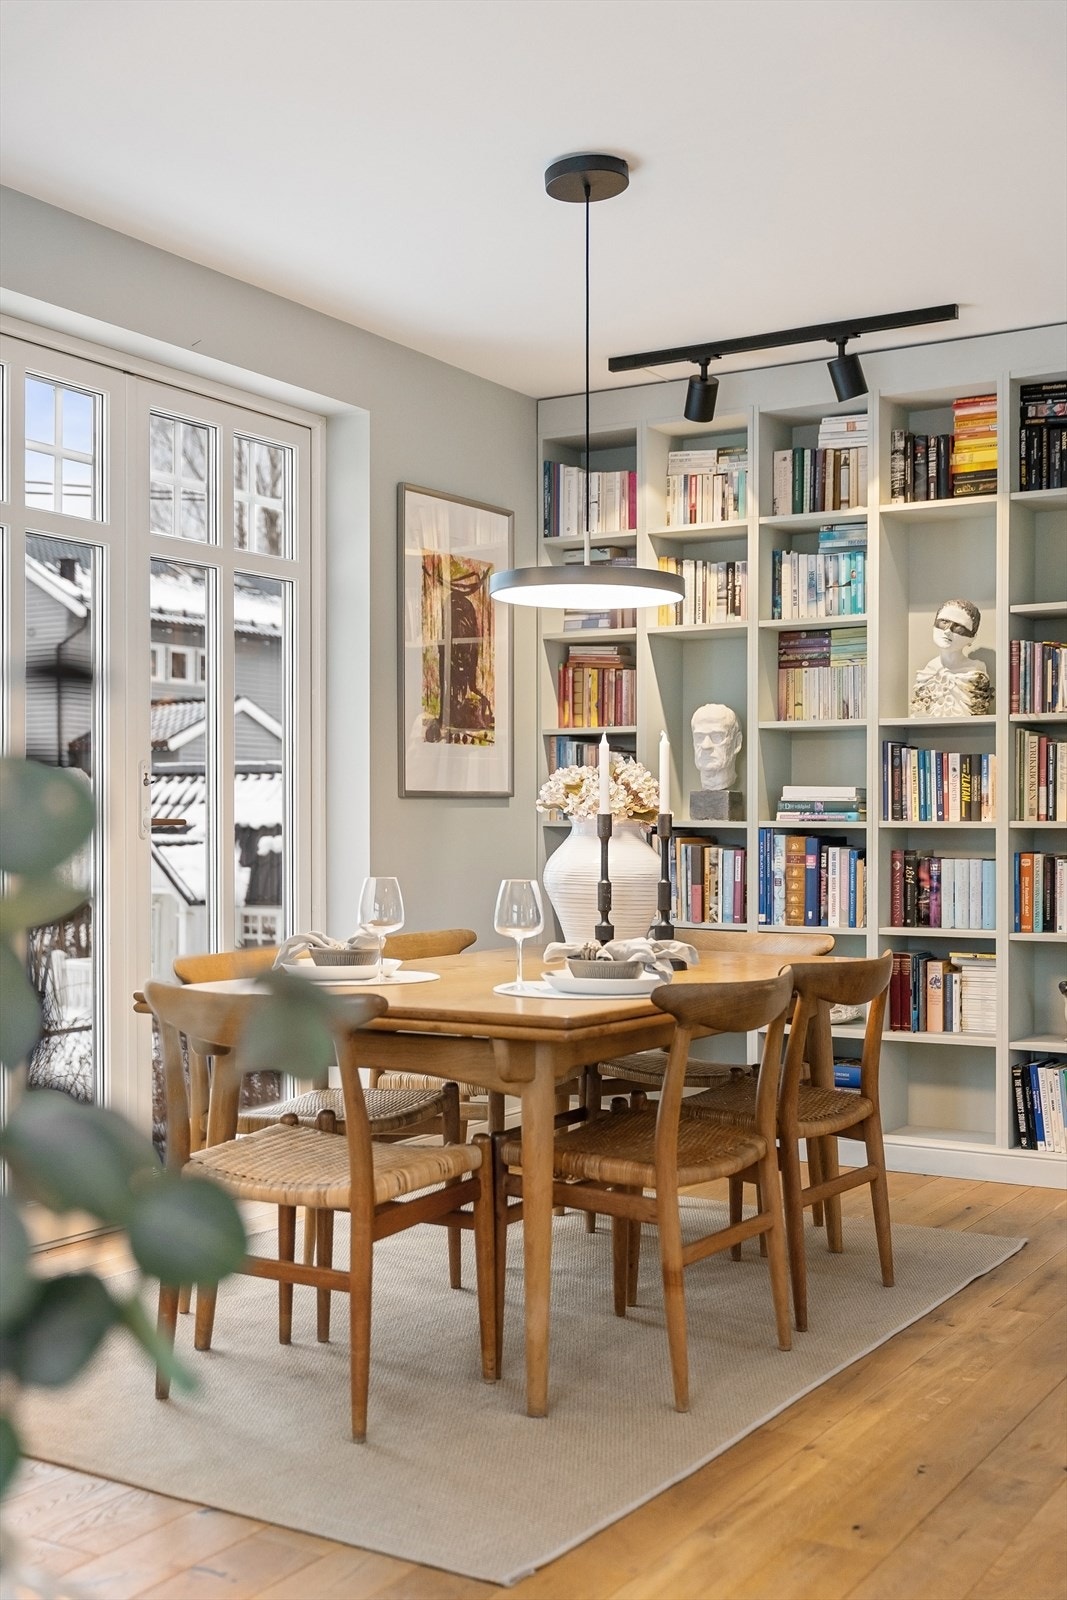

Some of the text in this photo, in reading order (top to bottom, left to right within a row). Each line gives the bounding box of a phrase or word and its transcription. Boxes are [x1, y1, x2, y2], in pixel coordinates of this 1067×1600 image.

[928, 447, 937, 461] ELON
[928, 461, 937, 478] MUSK
[1029, 741, 1037, 801] LYRIKKBOKEN
[951, 774, 959, 802] Sapiens
[961, 773, 971, 802] ZLATAN
[906, 865, 914, 883] 1814
[1017, 1113, 1026, 1133] SOLUTION
